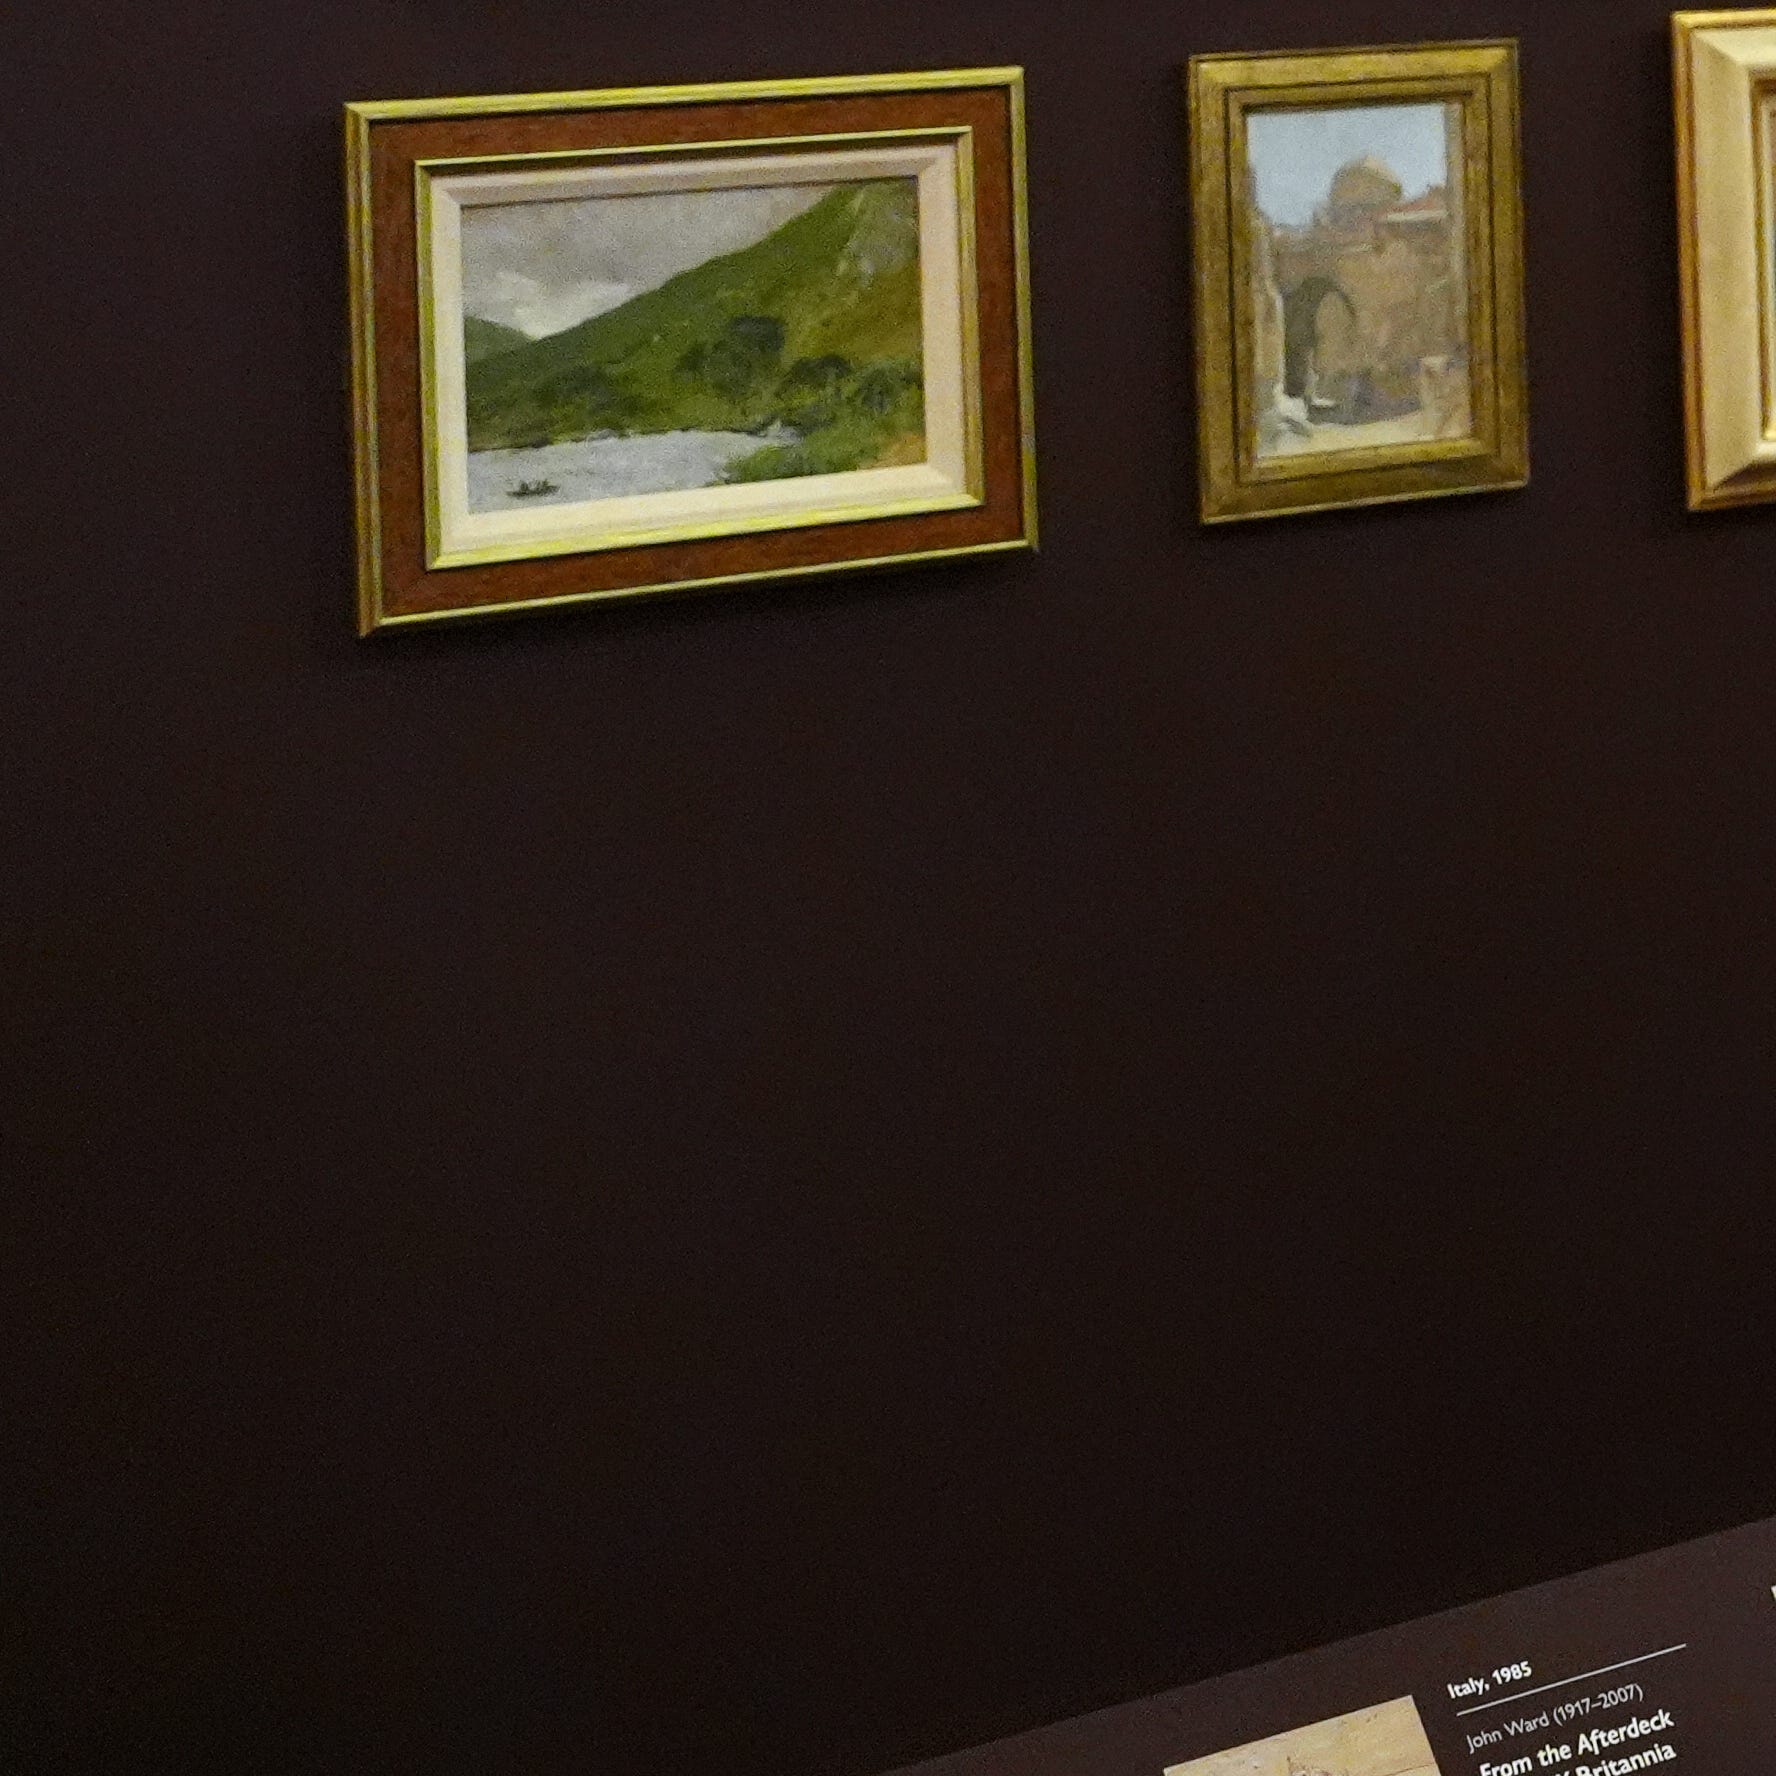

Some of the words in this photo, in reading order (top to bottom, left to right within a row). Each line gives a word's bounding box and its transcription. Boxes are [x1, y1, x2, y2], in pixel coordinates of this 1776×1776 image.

[1447, 1677, 1490, 1699] Italy,
[1492, 1661, 1532, 1686] 1985
[1467, 1730, 1502, 1754] John
[1504, 1711, 1550, 1737] Ward
[1480, 1756, 1533, 1776] From
[1537, 1744, 1572, 1766] the
[1578, 1709, 1675, 1755] Afterdeck
